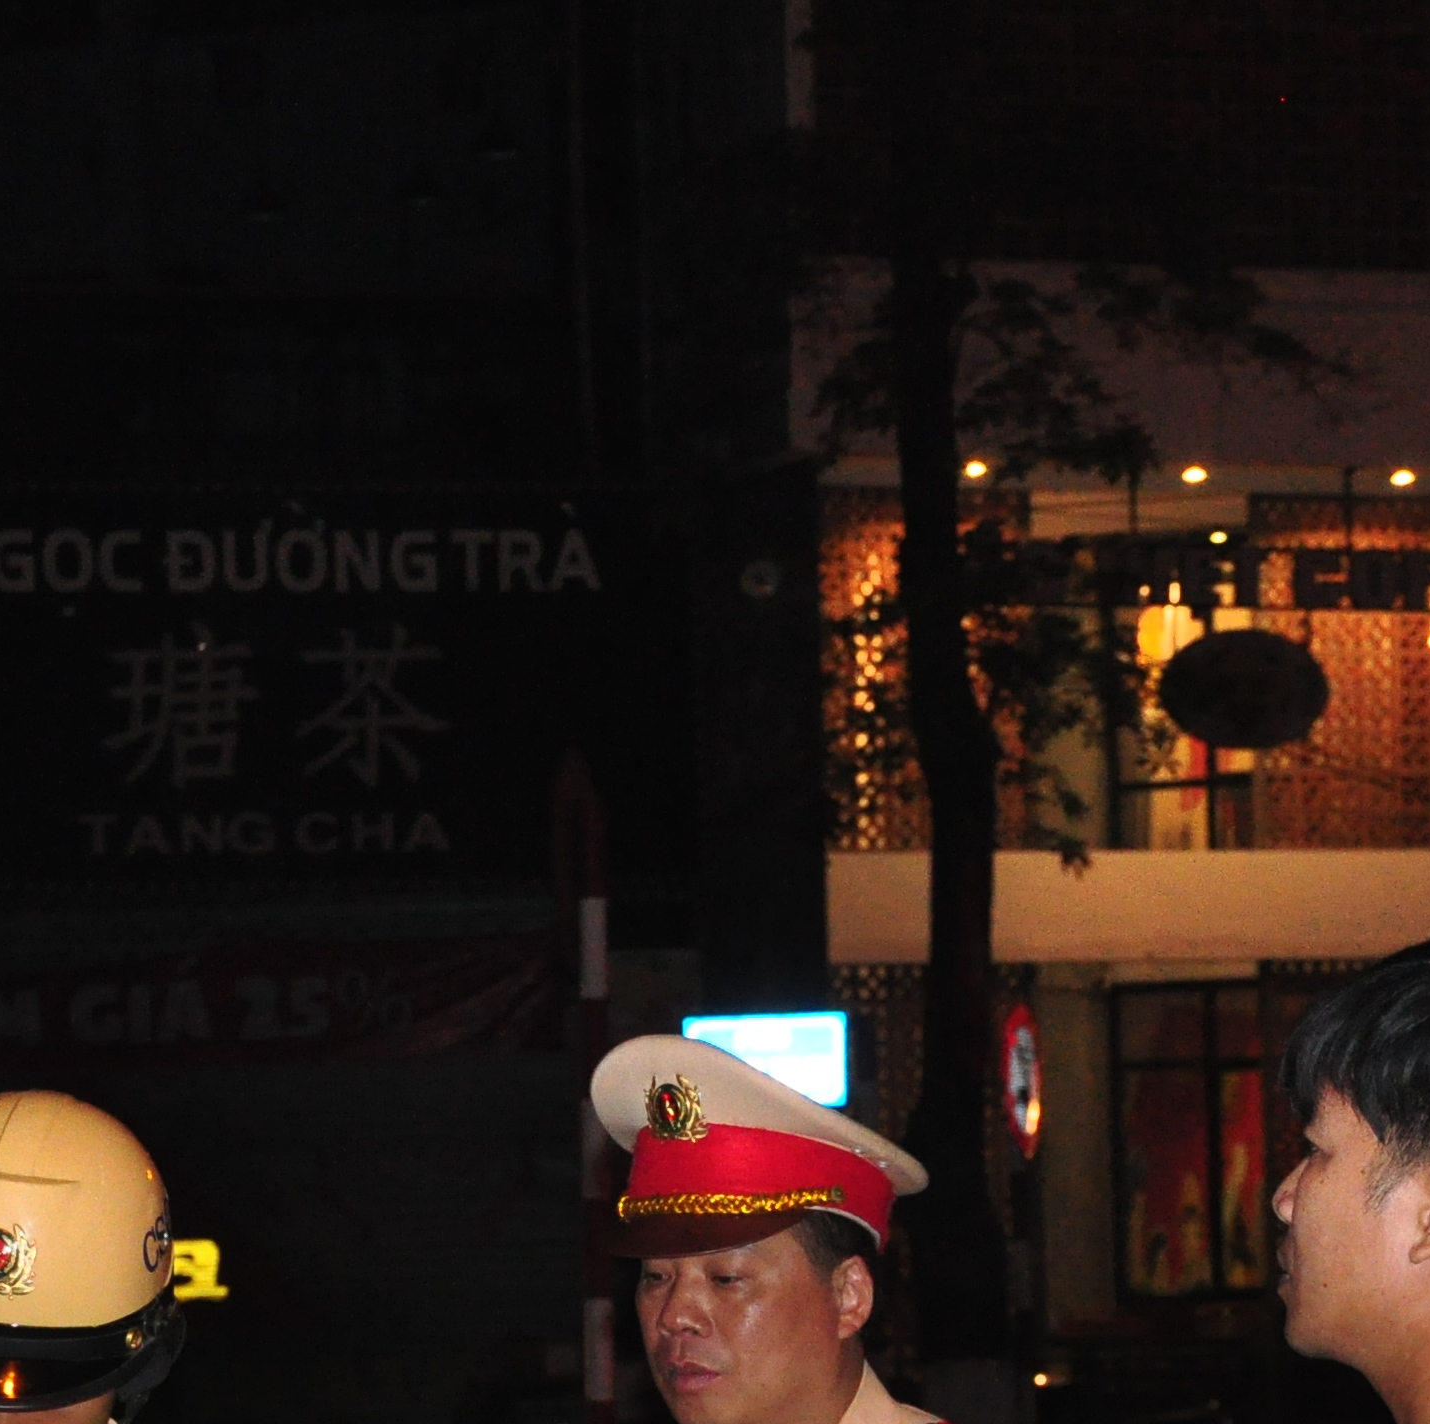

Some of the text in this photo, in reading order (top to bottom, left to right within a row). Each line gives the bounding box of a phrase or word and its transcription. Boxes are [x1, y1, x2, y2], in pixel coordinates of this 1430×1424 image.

[448, 501, 603, 594] TRÀ
[81, 809, 452, 857] TANG CHA
[70, 956, 214, 1046] GIÁ
[236, 966, 416, 1041] 25%
